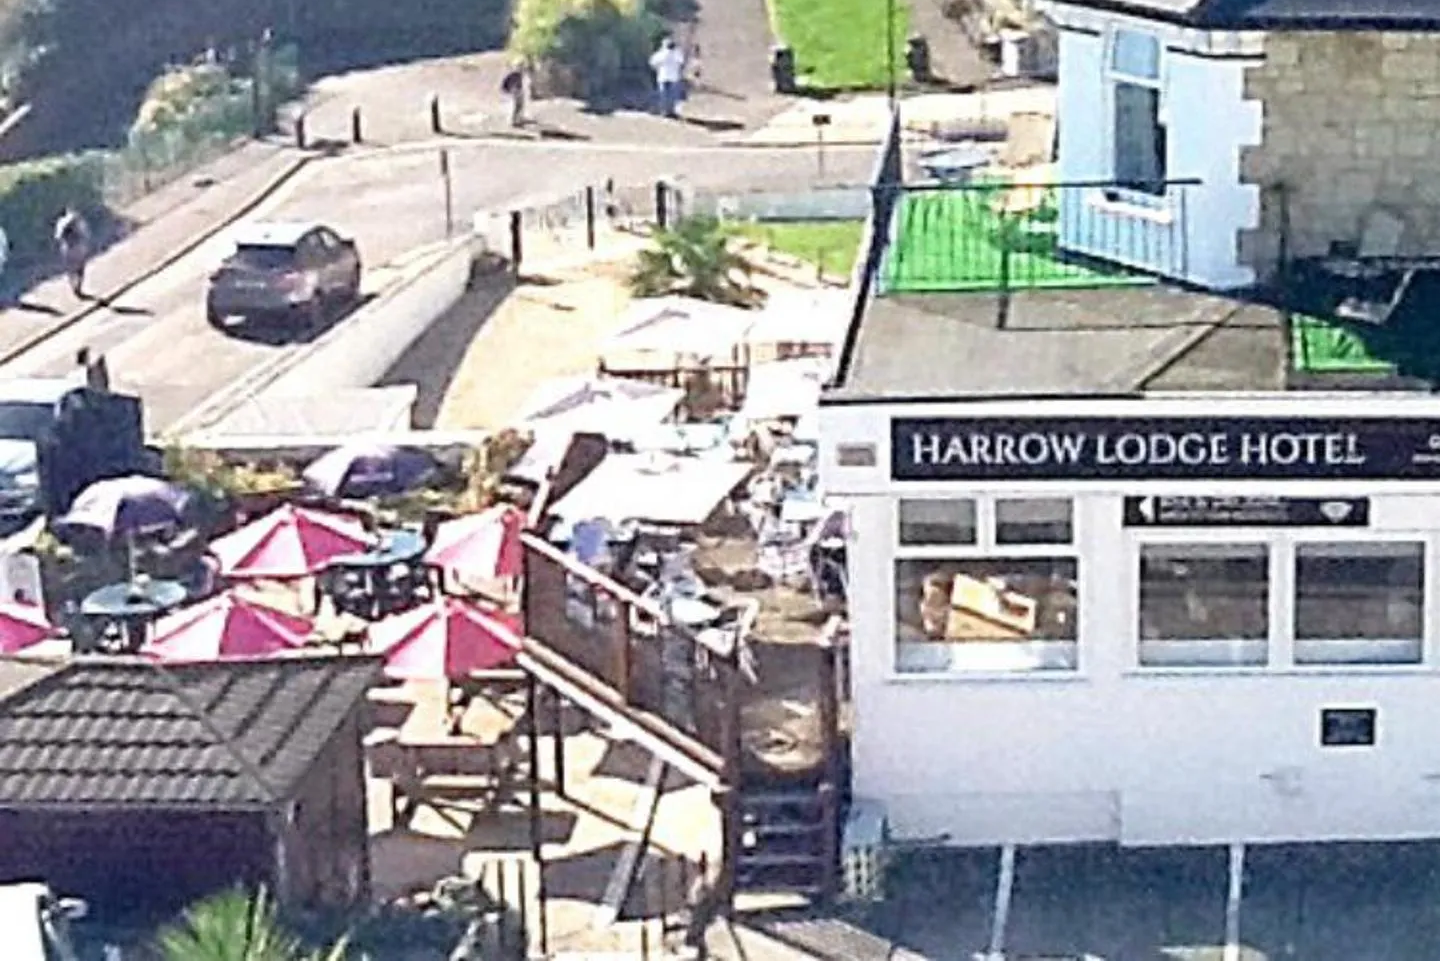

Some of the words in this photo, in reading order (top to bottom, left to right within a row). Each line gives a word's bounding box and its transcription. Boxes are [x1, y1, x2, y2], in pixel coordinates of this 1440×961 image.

[912, 433, 1085, 464] HARROW
[1097, 433, 1230, 464] LODGE
[1241, 433, 1366, 464] HOTEL
